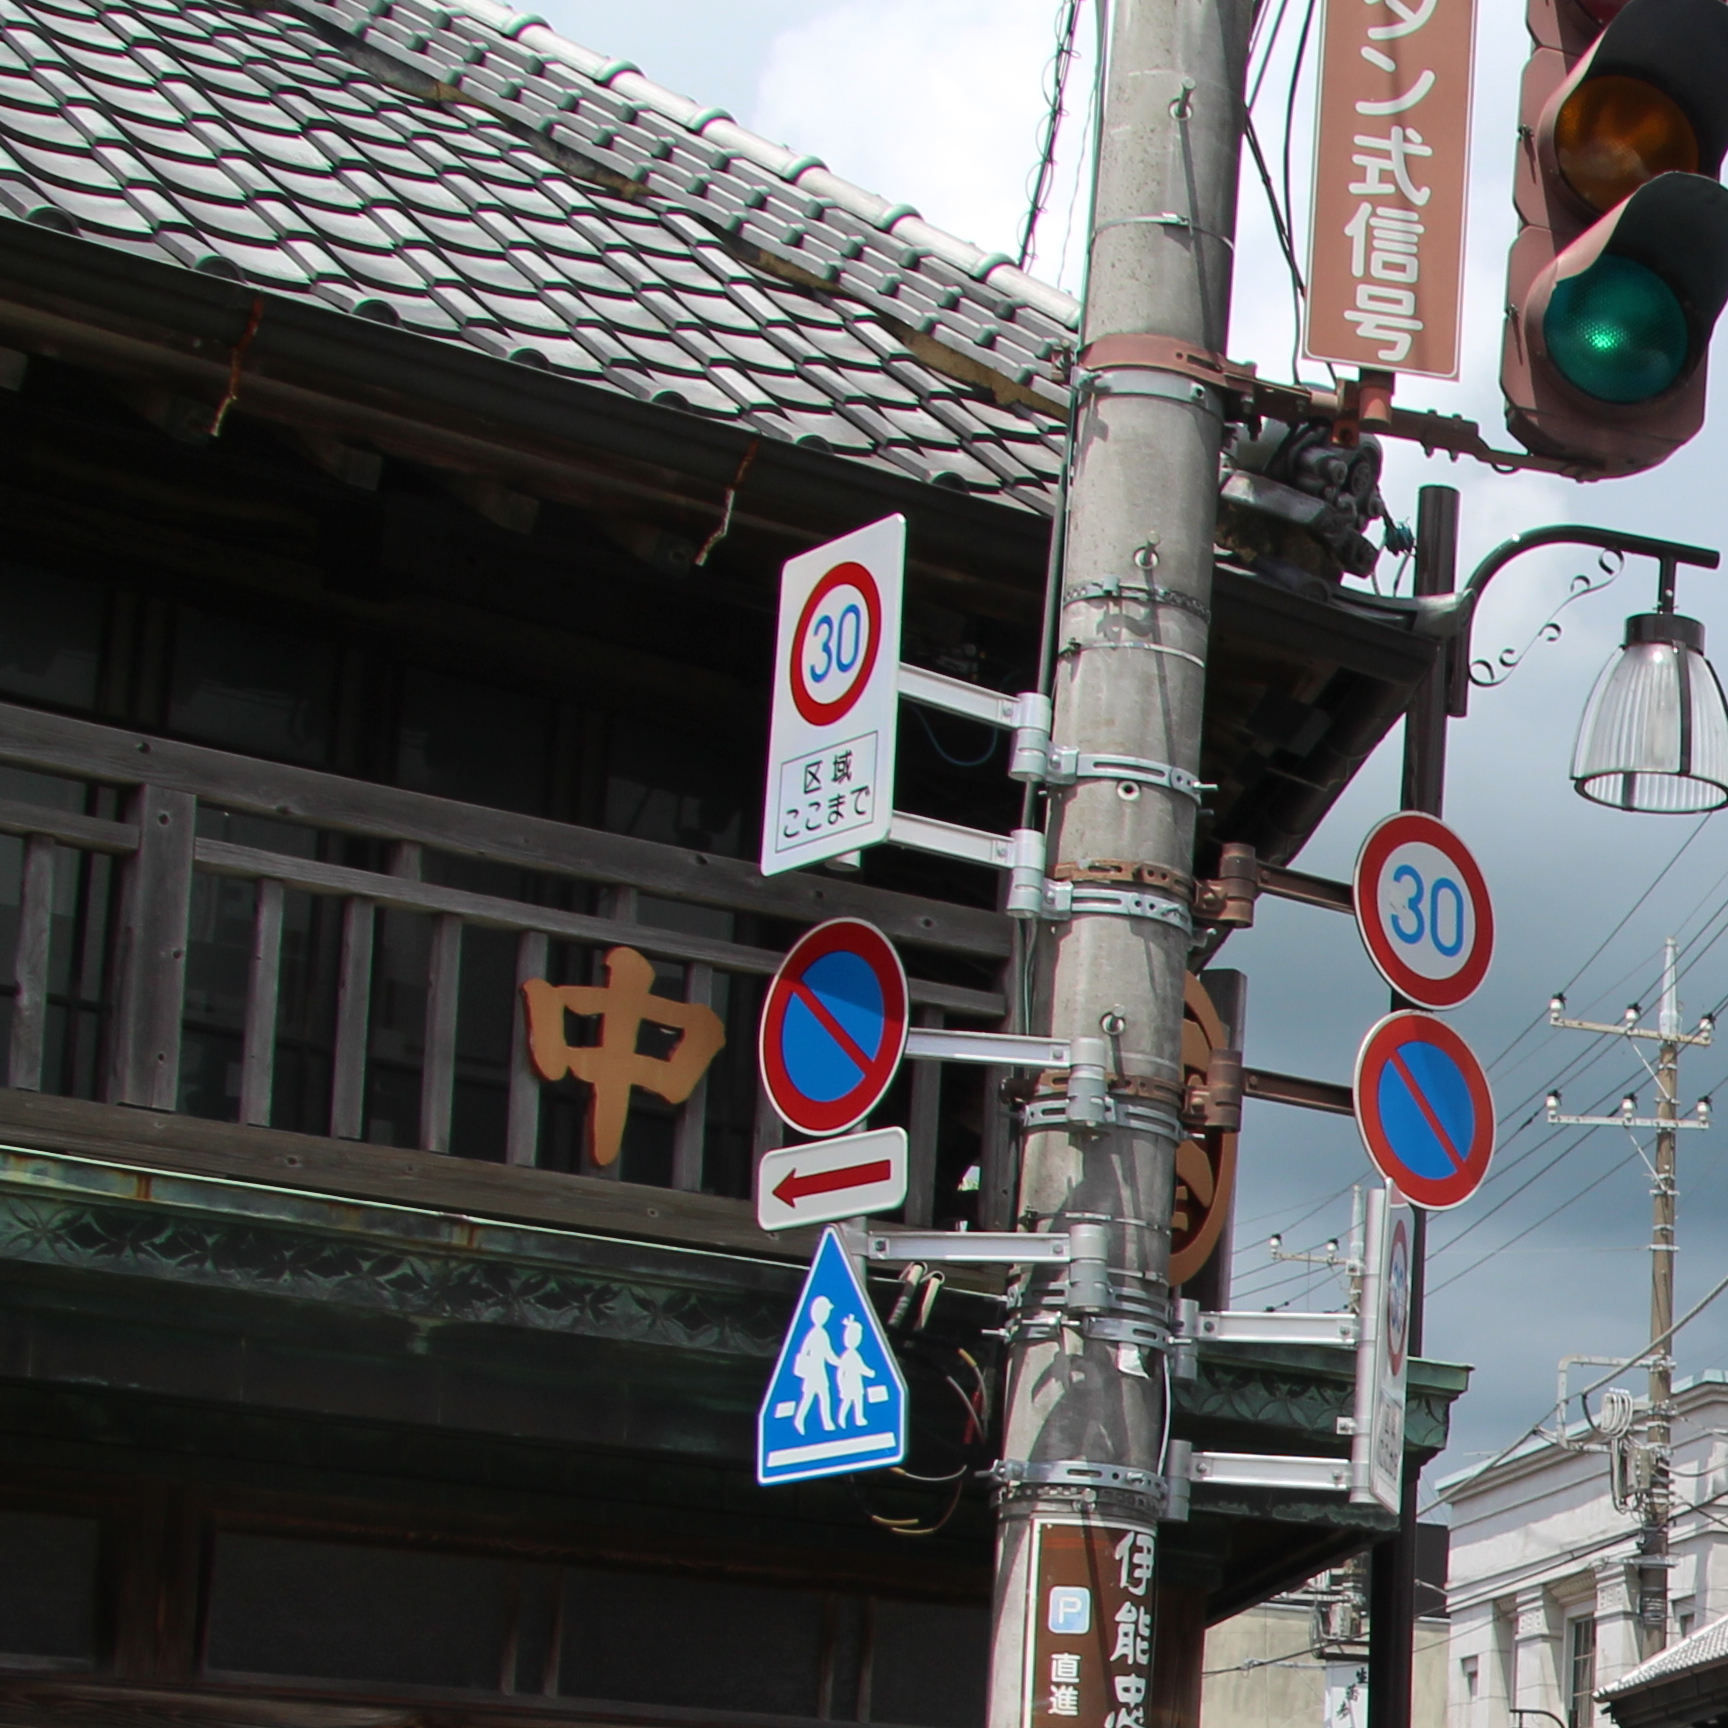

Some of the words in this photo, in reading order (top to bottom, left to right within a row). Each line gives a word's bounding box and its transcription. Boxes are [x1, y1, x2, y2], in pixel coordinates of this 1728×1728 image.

[809, 603, 861, 684] 30
[803, 750, 852, 795] 区域
[783, 785, 870, 838] ここまで
[1390, 863, 1465, 958] 30
[521, 945, 727, 1167] 中
[1057, 1596, 1083, 1625] P
[1047, 1652, 1082, 1717] 直進
